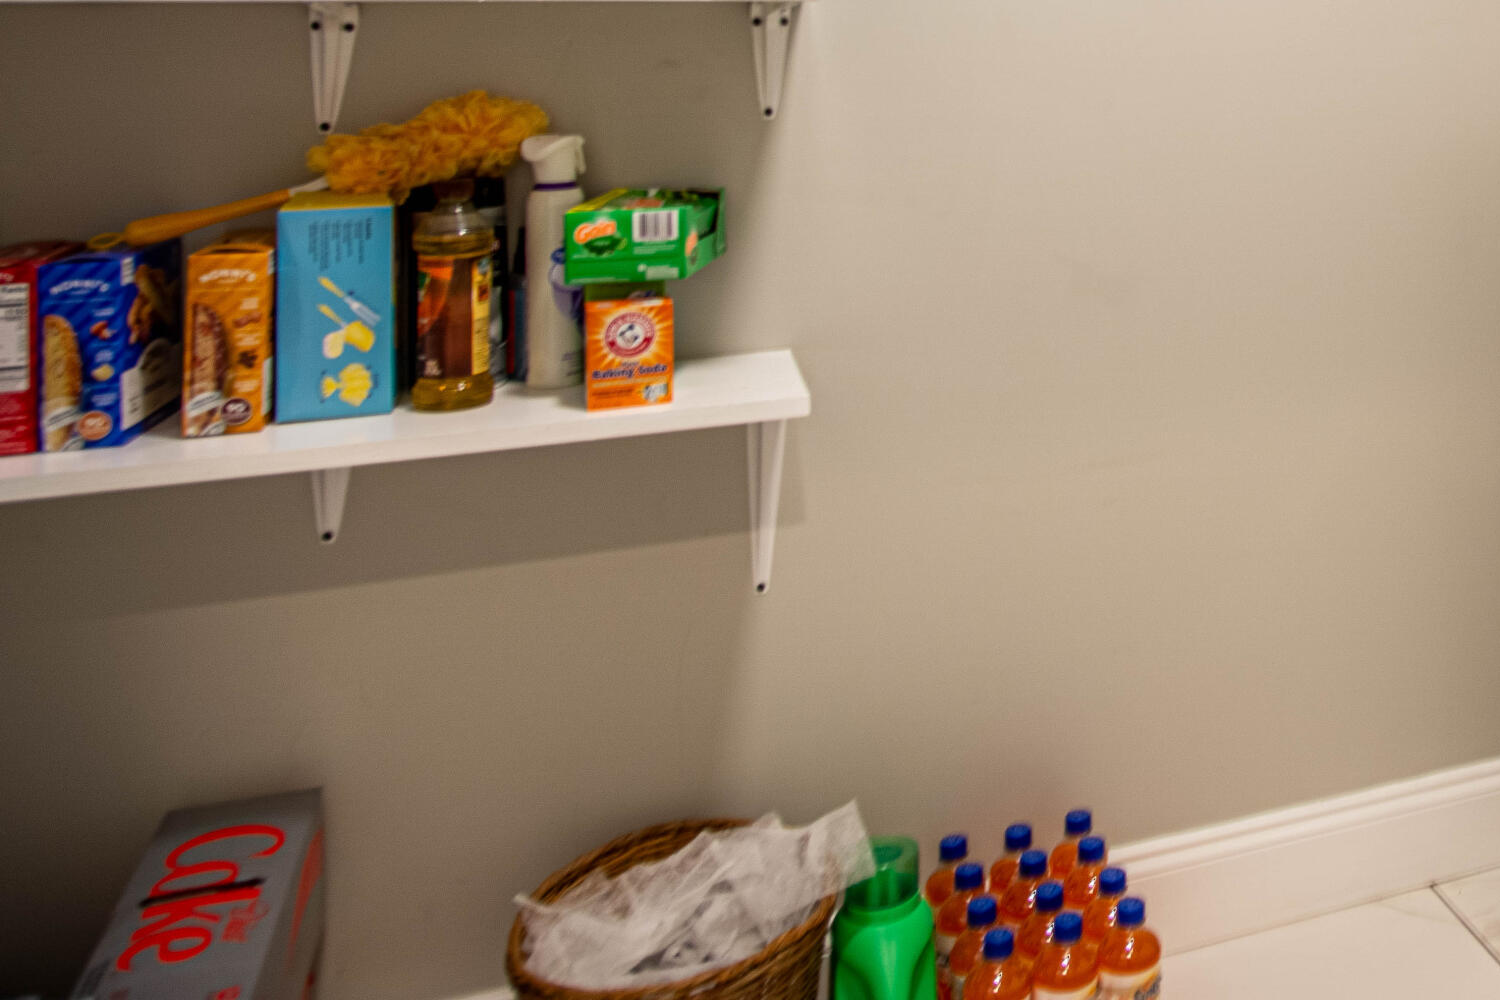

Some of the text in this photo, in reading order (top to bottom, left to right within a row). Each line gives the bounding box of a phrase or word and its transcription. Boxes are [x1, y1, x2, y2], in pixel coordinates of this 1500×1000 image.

[592, 364, 668, 379] Baking Soda
[115, 823, 286, 972] Coke
